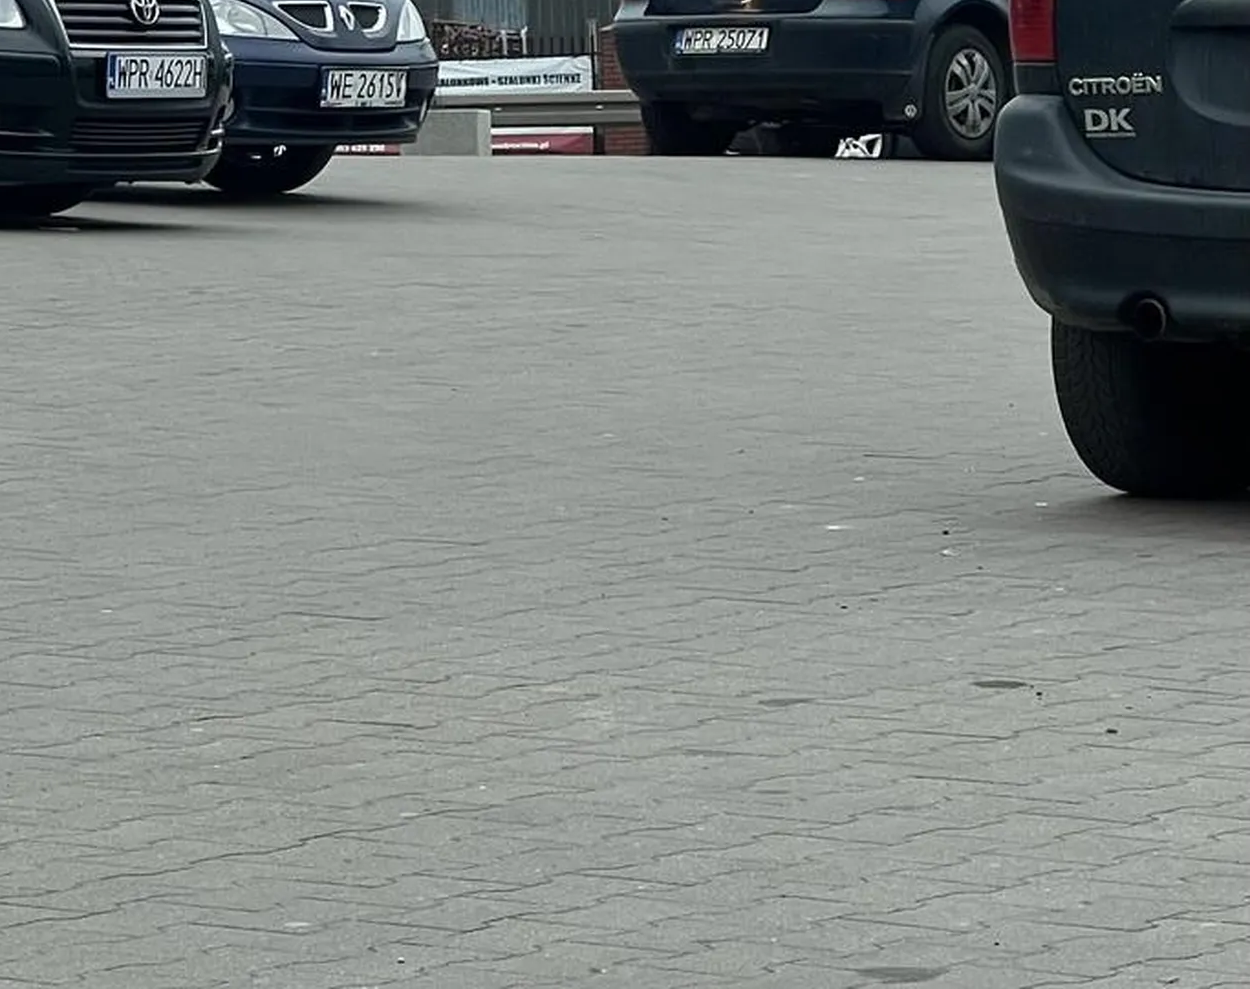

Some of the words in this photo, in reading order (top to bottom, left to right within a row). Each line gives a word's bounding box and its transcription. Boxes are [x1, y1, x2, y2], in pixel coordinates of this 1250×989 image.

[683, 29, 714, 50] WPR
[118, 59, 150, 89] WPR
[154, 58, 203, 88] 4622H
[330, 72, 354, 99] WE
[1068, 72, 1163, 96] CITROËN
[1083, 108, 1134, 131] DK
